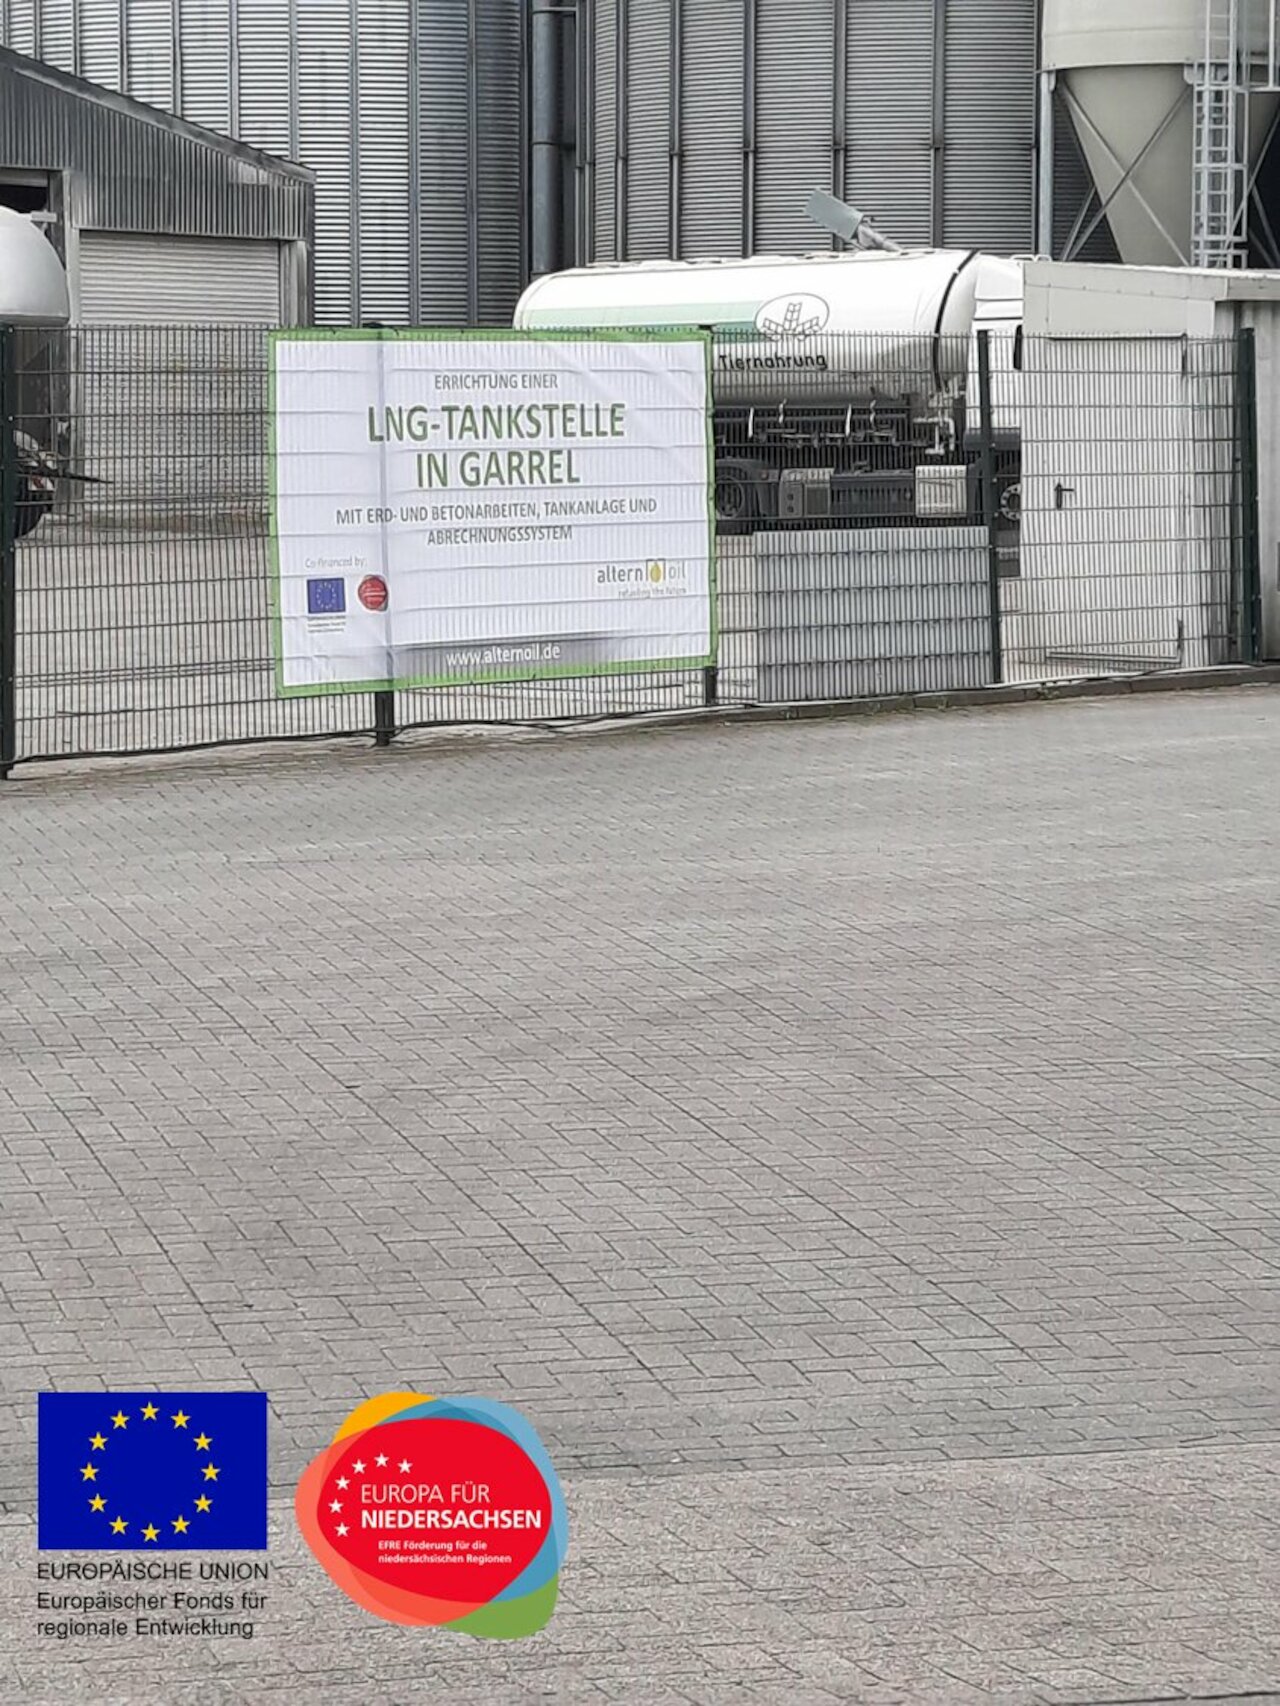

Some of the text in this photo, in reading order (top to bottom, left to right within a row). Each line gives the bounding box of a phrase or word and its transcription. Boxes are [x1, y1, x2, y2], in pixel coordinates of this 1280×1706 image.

[719, 353, 828, 371] Tiernahrung
[434, 373, 558, 390] ERRICHTUNG EINER
[368, 402, 625, 442] LNG-TANKSTELLE
[416, 449, 580, 488] IN GARREL
[336, 496, 657, 525] MIT ERD- UND BETONARBEITEN, TANKANLAGE UND
[427, 524, 573, 546] ABRECHNUNGSSYSTEM
[445, 642, 561, 667] www.alternoil.de
